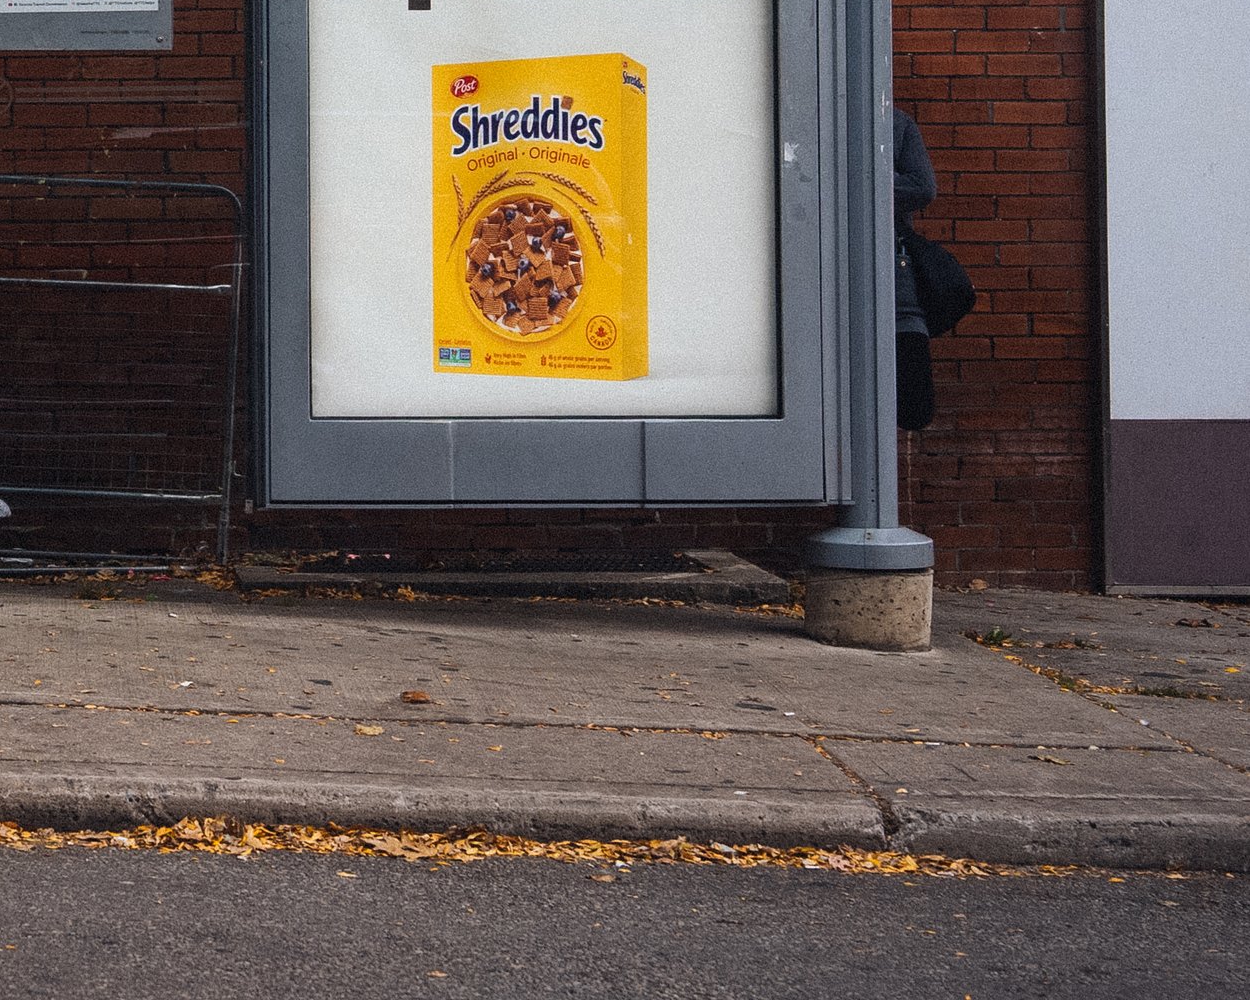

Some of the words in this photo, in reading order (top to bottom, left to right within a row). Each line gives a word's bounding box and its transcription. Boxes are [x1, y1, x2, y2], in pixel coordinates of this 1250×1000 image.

[454, 77, 478, 95] Post
[452, 96, 604, 155] Shreddies
[467, 147, 518, 171] Original
[529, 146, 591, 169] Originale
